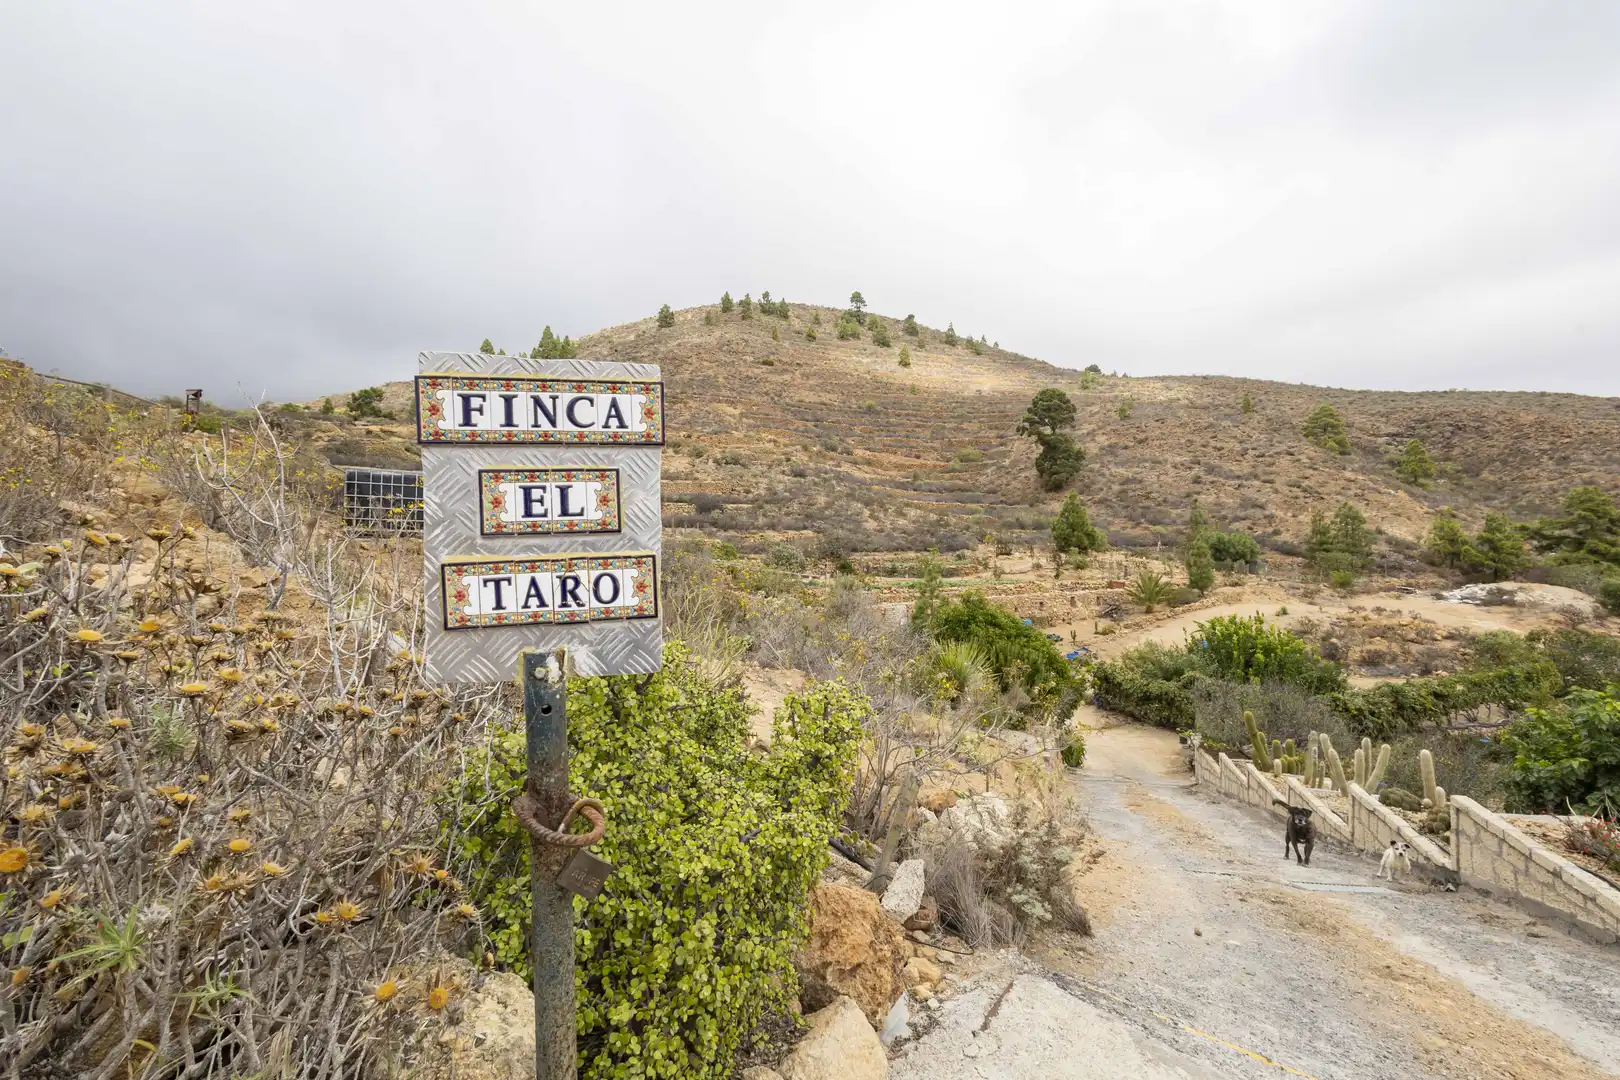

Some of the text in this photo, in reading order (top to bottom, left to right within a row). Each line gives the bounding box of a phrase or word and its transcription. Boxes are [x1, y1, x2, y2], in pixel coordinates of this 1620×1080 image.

[457, 392, 629, 430] FINCA
[518, 484, 585, 519] EL
[482, 572, 621, 611] TARO
